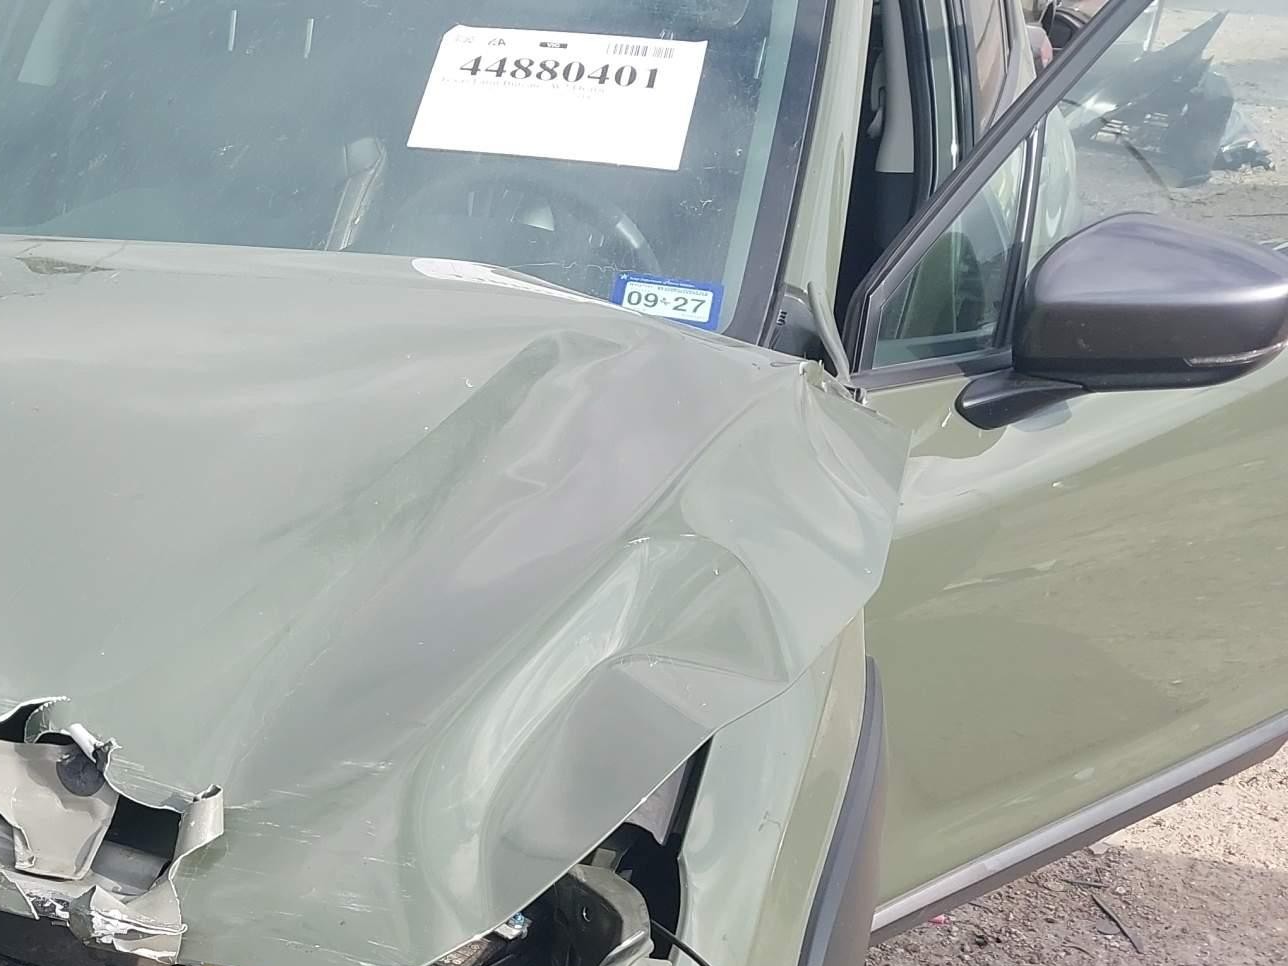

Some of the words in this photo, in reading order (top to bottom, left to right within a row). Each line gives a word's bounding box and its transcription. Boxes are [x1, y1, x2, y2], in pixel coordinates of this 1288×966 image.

[460, 55, 659, 89] 44880401
[626, 290, 659, 308] 09
[671, 296, 707, 313] 27
